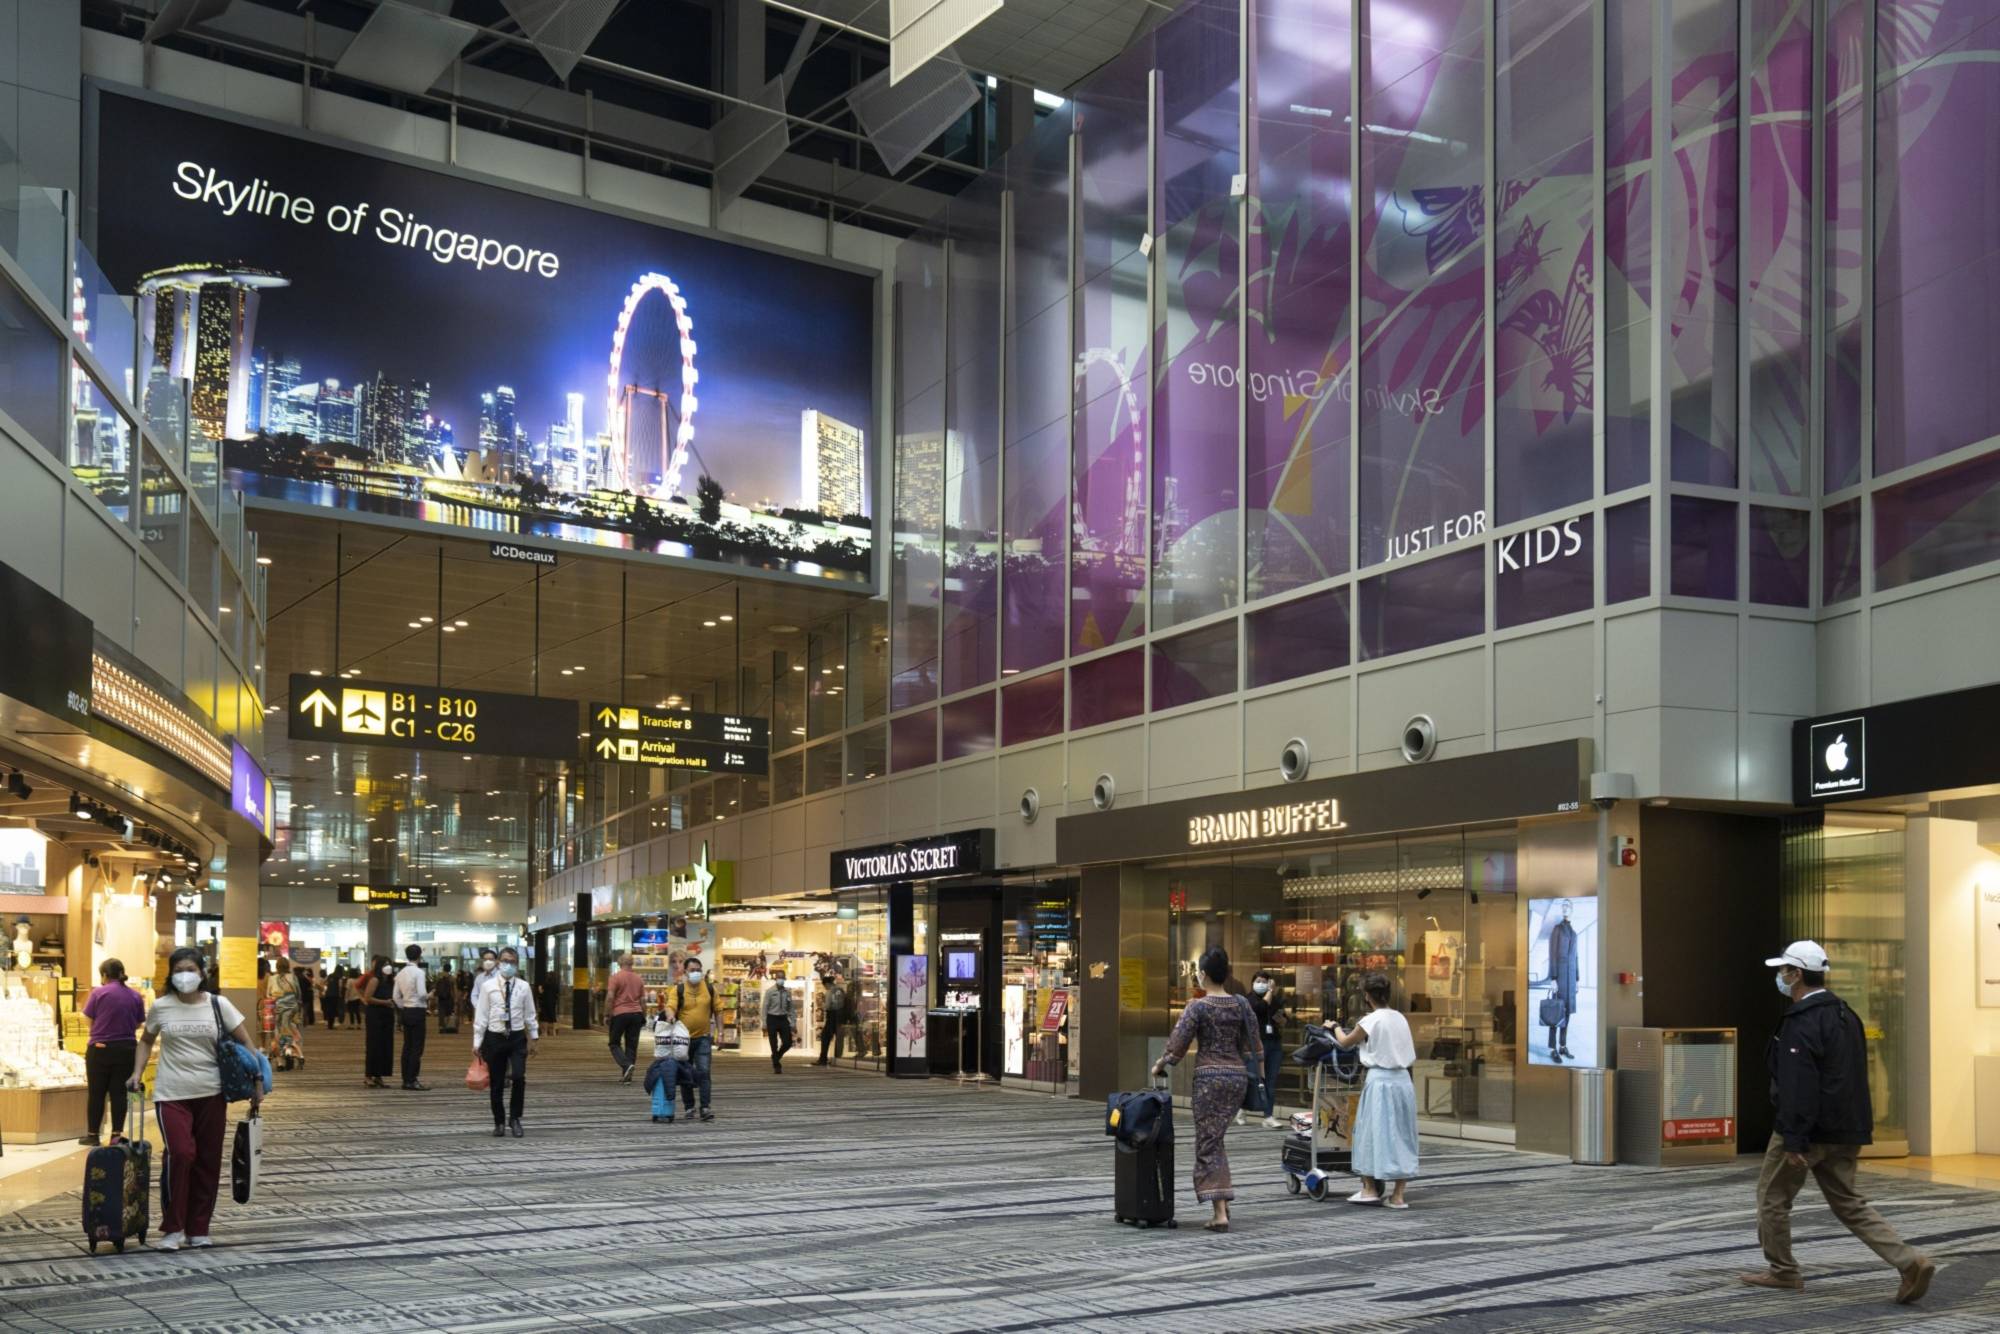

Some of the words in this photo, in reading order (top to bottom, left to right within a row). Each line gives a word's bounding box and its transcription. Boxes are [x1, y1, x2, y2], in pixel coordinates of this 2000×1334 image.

[172, 161, 315, 224] Skyline
[327, 202, 369, 235] of
[375, 207, 560, 278] Singapore
[1385, 526, 1434, 562] JUST
[1444, 510, 1485, 544] FOR
[1498, 517, 1582, 574] KIDS
[492, 545, 555, 564] JCDecaux
[391, 692, 416, 713] B1
[439, 697, 477, 718] B10
[390, 717, 416, 738] C1
[437, 721, 476, 742] C26
[641, 715, 684, 729] Transfer
[684, 719, 692, 730] B
[641, 741, 676, 754] Arrival
[640, 754, 685, 766] Immigration
[685, 757, 700, 766] Hall
[701, 759, 707, 767] B
[1815, 781, 1839, 791] Premium
[1188, 809, 1258, 845] BRAUN
[845, 851, 907, 880] VICTORIA'S
[910, 846, 956, 873] SECRET
[369, 889, 400, 899] Transfer
